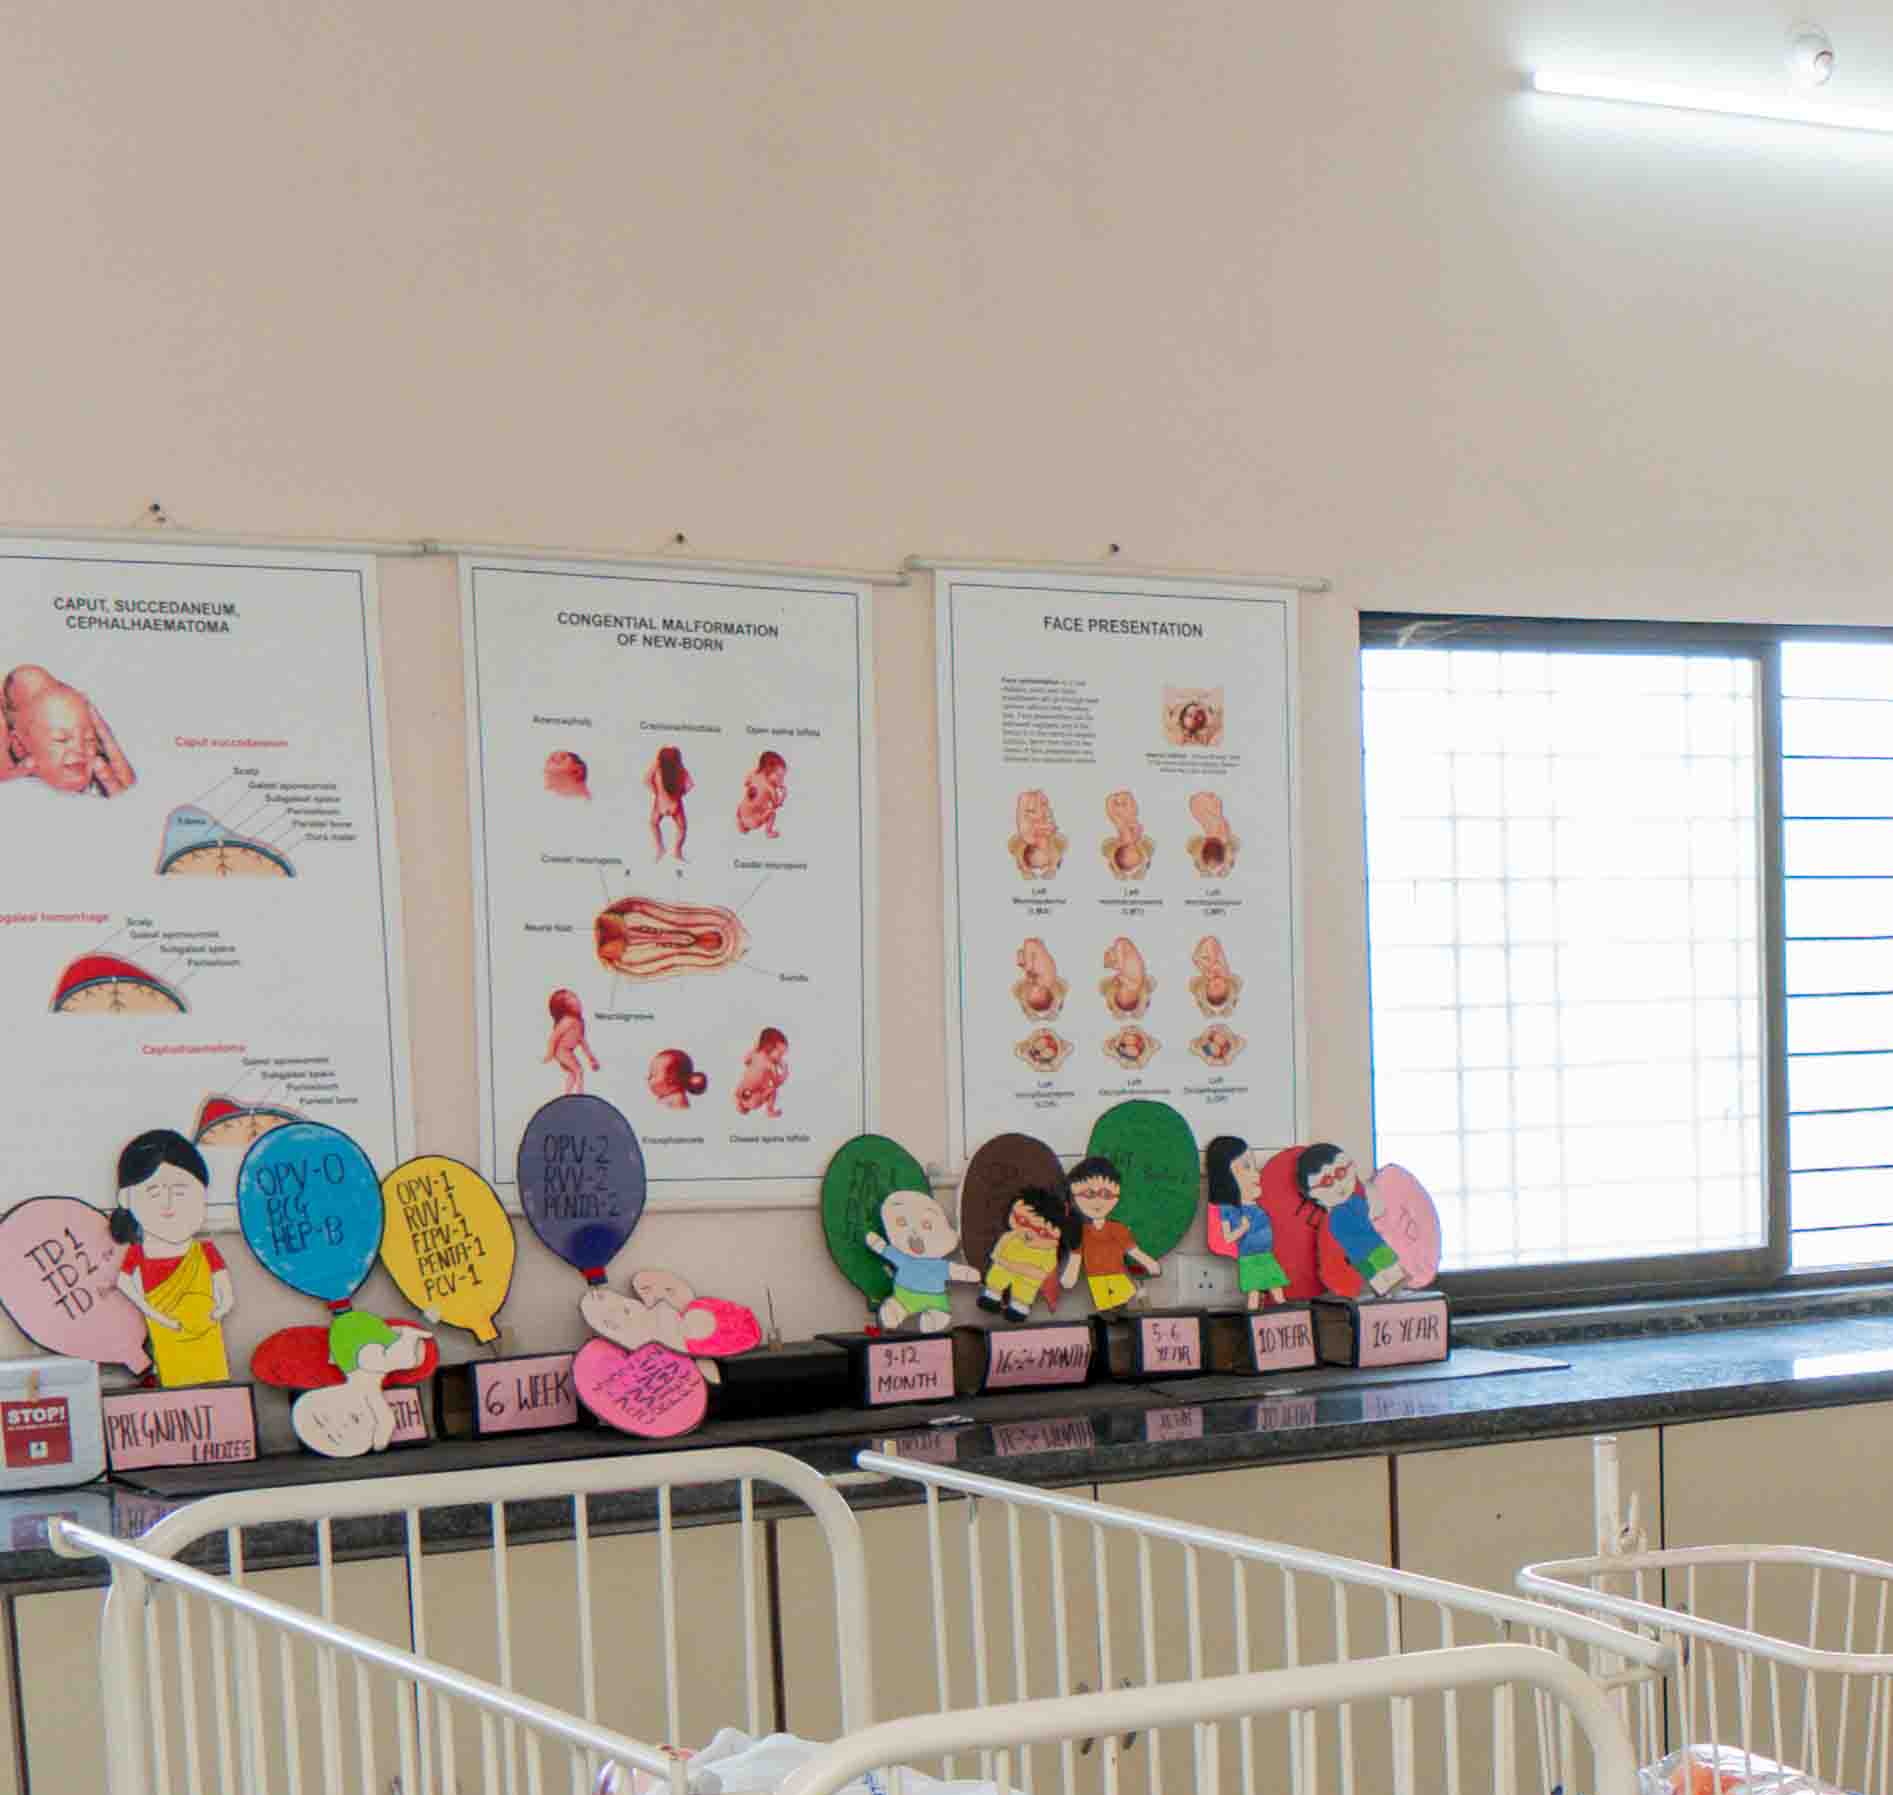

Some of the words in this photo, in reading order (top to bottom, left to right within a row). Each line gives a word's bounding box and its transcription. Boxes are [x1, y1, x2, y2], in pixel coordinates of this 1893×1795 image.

[53, 597, 111, 613] CAPUT,
[115, 600, 240, 617] SUCCEDANEUM,
[65, 616, 230, 633] CEPHALHAEMATOMA
[557, 612, 657, 631] CONGENTIAL
[662, 618, 779, 638] MALFORMATION
[1043, 616, 1084, 632] FACE
[1088, 618, 1203, 638] PRESENTATION
[617, 633, 638, 647] OF
[643, 636, 724, 652] NEW-BORN
[396, 1169, 454, 1206] OPV-1
[24, 1238, 65, 1272] TD
[41, 1263, 79, 1296] TD
[75, 1250, 99, 1275] 2
[55, 1287, 95, 1321] TD
[1371, 1321, 1392, 1348] 16
[1399, 1314, 1440, 1342] YEAR
[484, 1383, 504, 1417] 6
[516, 1372, 572, 1410] WEEK
[878, 1371, 937, 1393] MONTH
[7, 1406, 66, 1426] STOP!
[107, 1404, 214, 1451] PREGNANT
